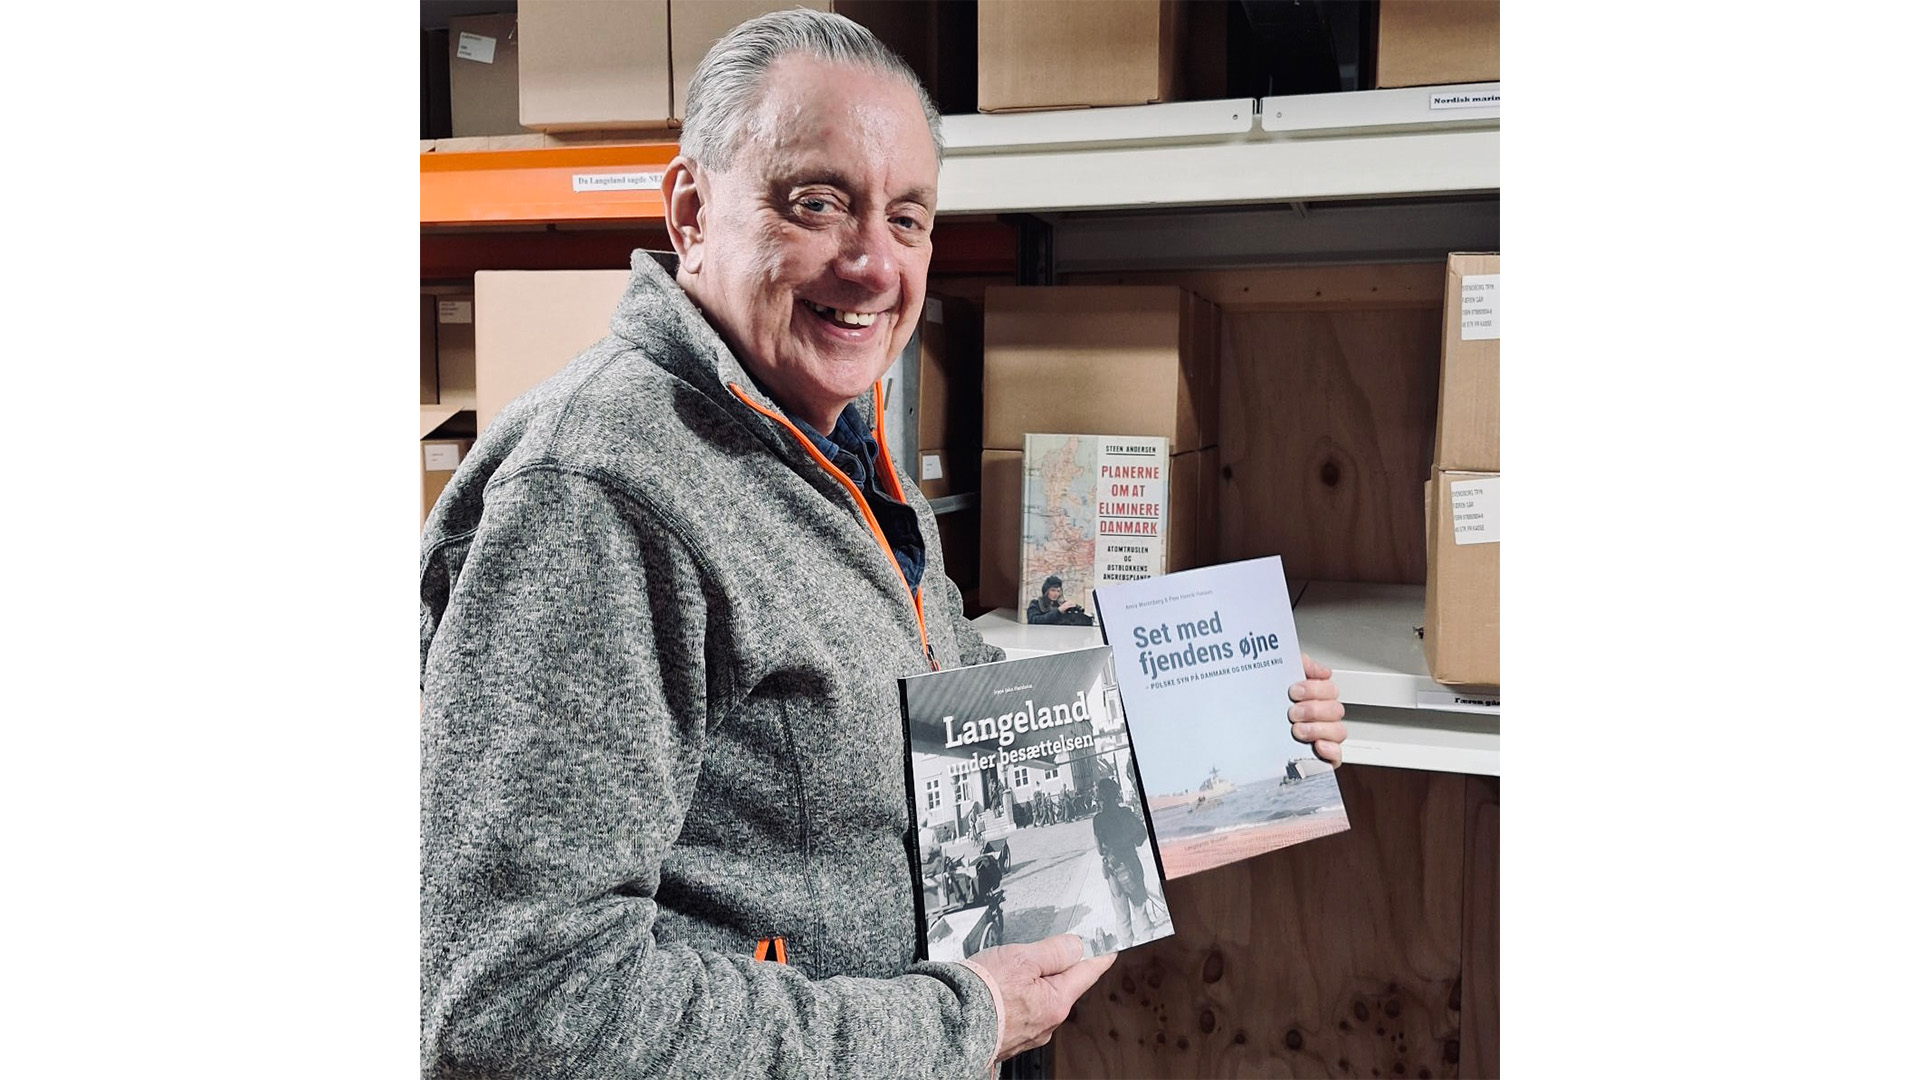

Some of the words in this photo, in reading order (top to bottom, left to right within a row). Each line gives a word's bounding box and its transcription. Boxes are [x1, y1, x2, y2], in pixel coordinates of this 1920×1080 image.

[1434, 96, 1470, 104] Nordisk
[590, 176, 625, 185] Langeland
[627, 176, 646, 184] sagde
[1126, 445, 1156, 453] ANDERSEN
[1101, 465, 1160, 480] PLANERNE
[1111, 484, 1129, 497] OM
[1132, 484, 1145, 497] AT
[1098, 502, 1160, 516] ELIMINERE
[1100, 520, 1158, 534] DANMARK
[1107, 545, 1149, 553] ATOMTRUSLEN
[1107, 564, 1148, 572] ØSTBLOKKENS
[1133, 623, 1172, 648] Set
[1176, 610, 1223, 641] med
[1139, 642, 1234, 680] fjendens
[1239, 631, 1279, 660] øjne
[1150, 678, 1175, 690] POLSKE
[1176, 676, 1190, 685] SYN
[1190, 673, 1200, 683] PÅ
[1200, 668, 1230, 680] DANMARK
[1231, 665, 1241, 674] OG
[1241, 663, 1253, 672] DEN
[1253, 660, 1271, 670] KOLDE
[1271, 657, 1284, 666] KRIG
[943, 690, 1091, 749] Langeland
[948, 752, 997, 777] under
[998, 732, 1095, 766] besættelsen
